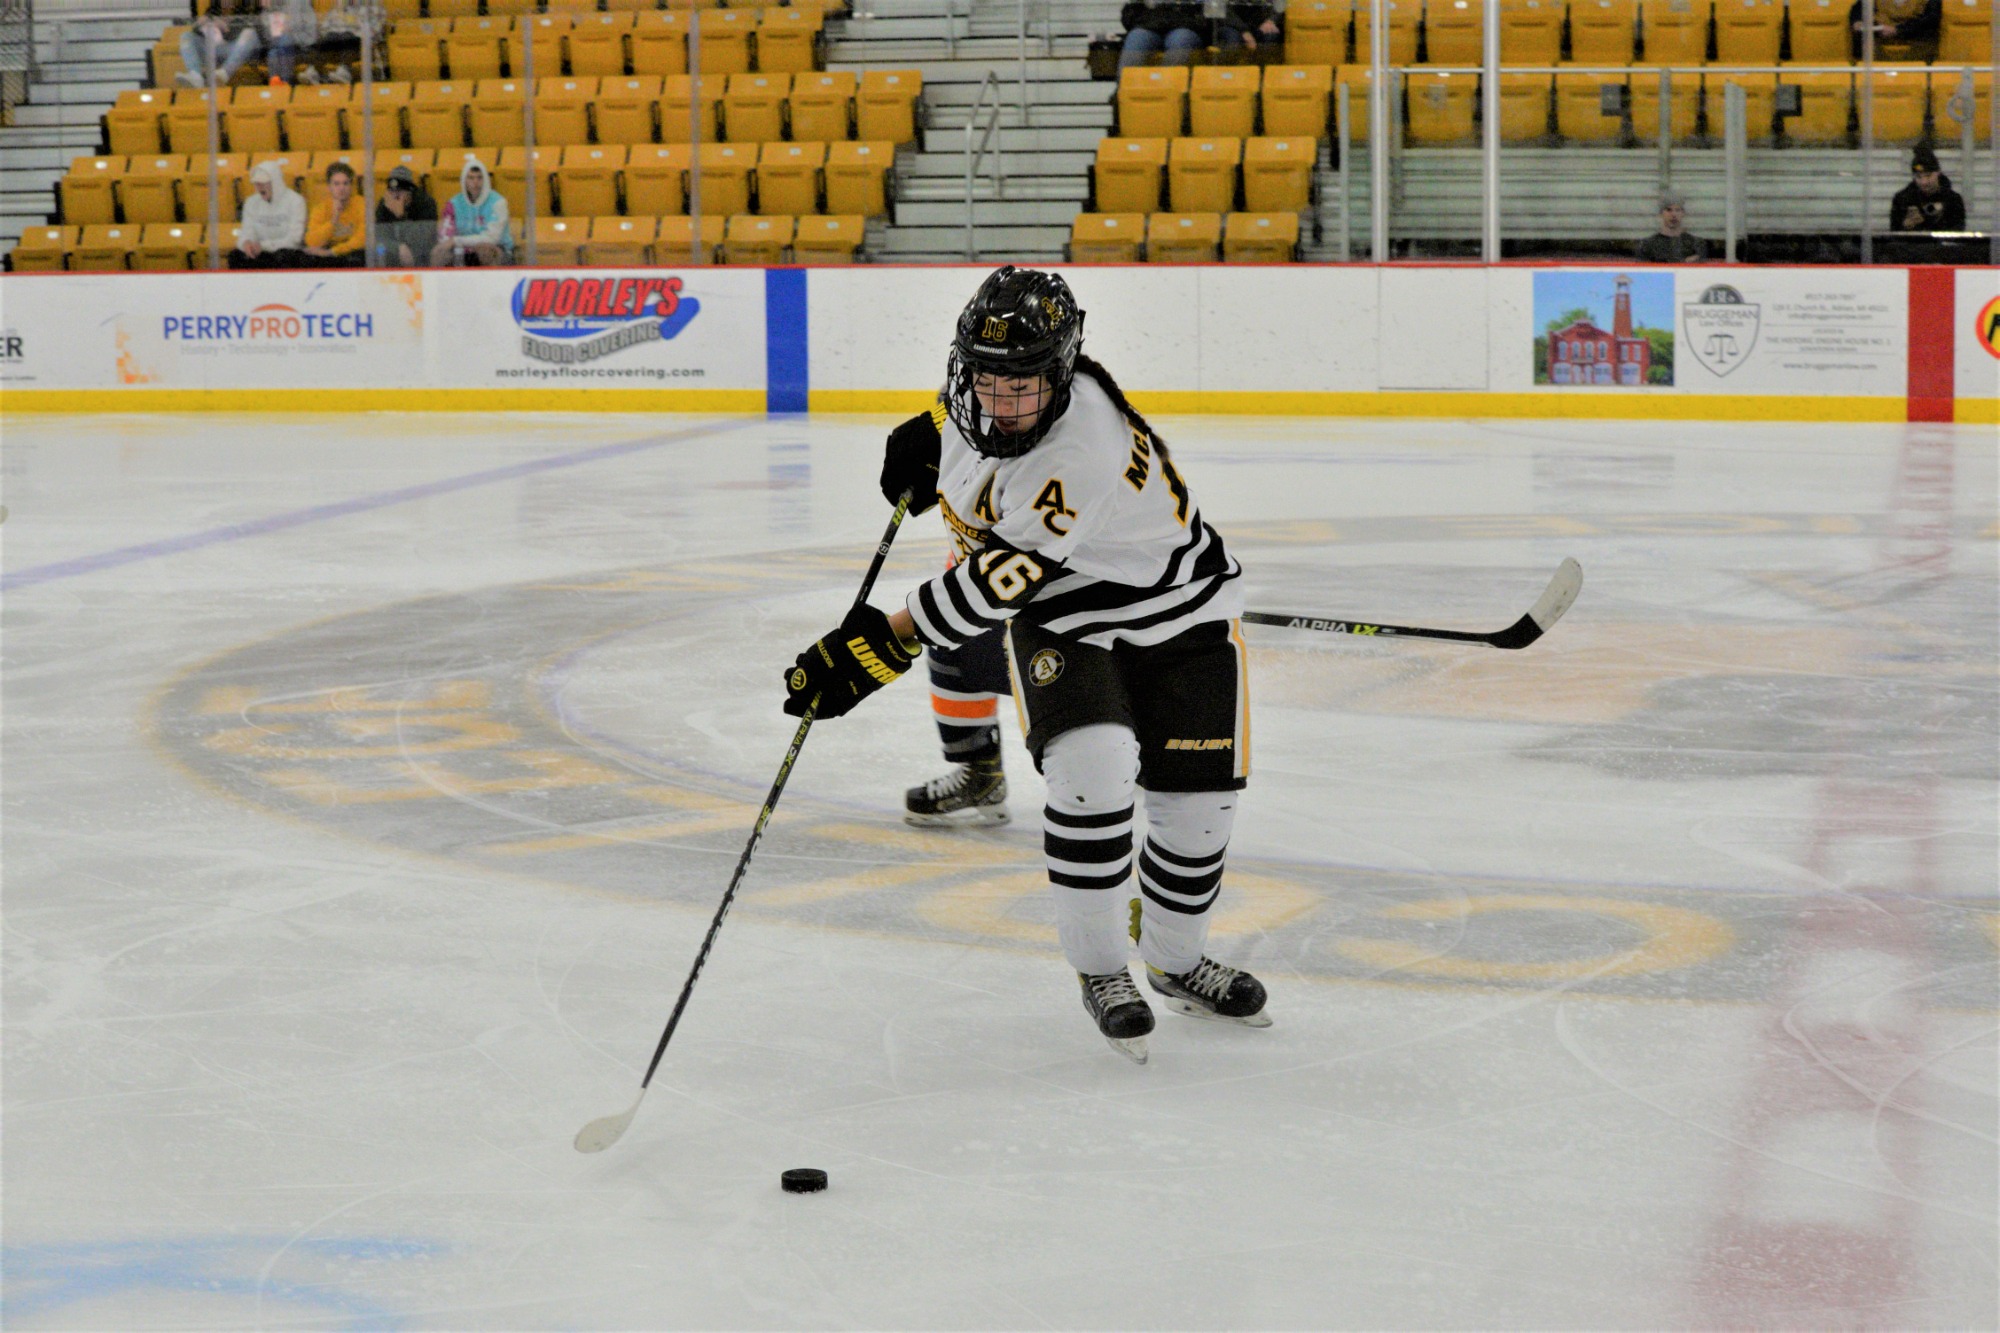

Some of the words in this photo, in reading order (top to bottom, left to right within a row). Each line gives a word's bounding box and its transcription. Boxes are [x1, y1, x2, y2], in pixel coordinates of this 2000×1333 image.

[522, 277, 683, 317] MORLEY'S
[522, 336, 575, 365] FLOOR
[576, 320, 660, 363] COVERING
[982, 316, 1008, 342] 16
[496, 366, 705, 380] morleysfloorcovering.com
[978, 549, 1043, 601] 16
[1288, 617, 1348, 634] ALPHA
[1352, 623, 1380, 637] LX
[792, 710, 813, 746] ALPHA
[1164, 738, 1233, 751] BAUER
